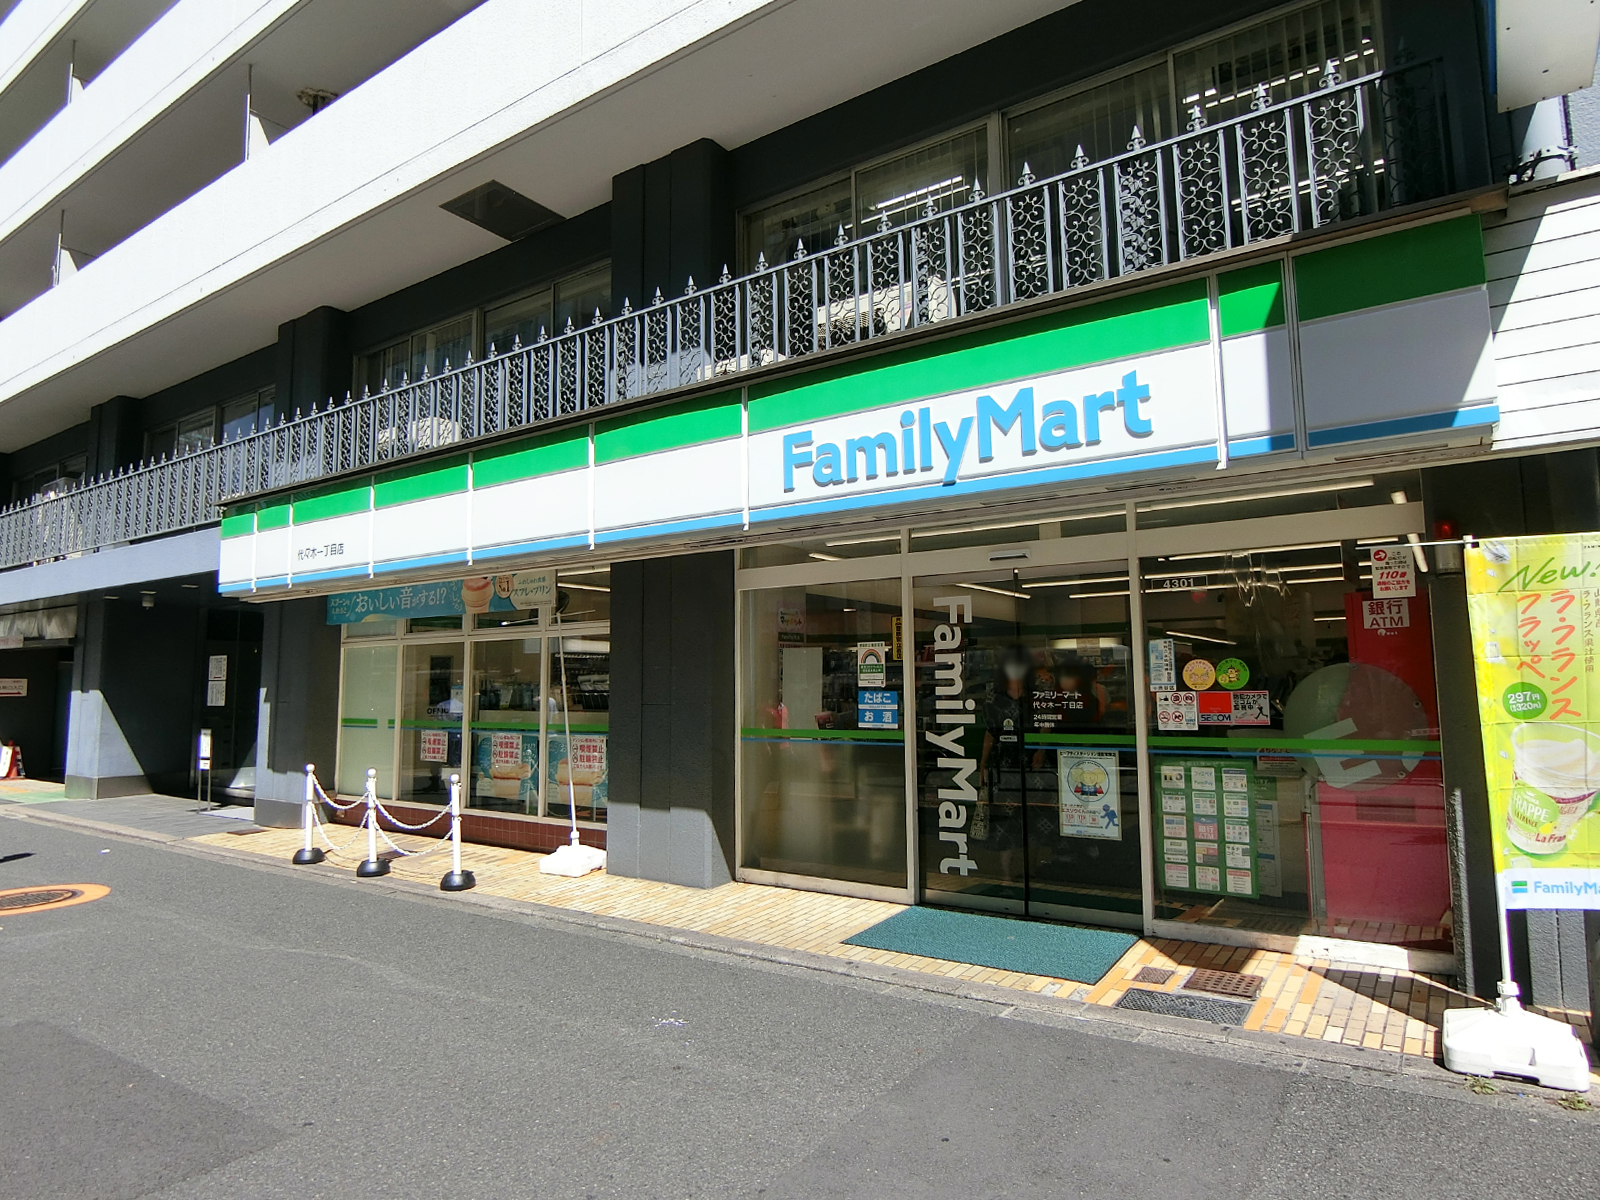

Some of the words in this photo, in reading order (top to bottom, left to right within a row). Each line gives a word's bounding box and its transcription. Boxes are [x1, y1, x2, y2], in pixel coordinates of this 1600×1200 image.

[782, 369, 1154, 493] FamilyMart
[297, 543, 344, 561] 代々木一丁目店
[1162, 578, 1195, 589] 4301
[1368, 600, 1403, 615] 銀行
[1370, 616, 1404, 628] ATM
[1516, 593, 1546, 679] フラッペ
[1550, 589, 1582, 721] ラ・フランス
[864, 692, 892, 703] たばこ
[1032, 690, 1082, 699] ファミリーマート
[1507, 691, 1541, 704] 297円
[1033, 701, 1084, 709] 代々木一丁目店
[925, 595, 979, 877] FamilyMart
[1513, 791, 1550, 823] FRAPPE
[1535, 833, 1546, 843] La
